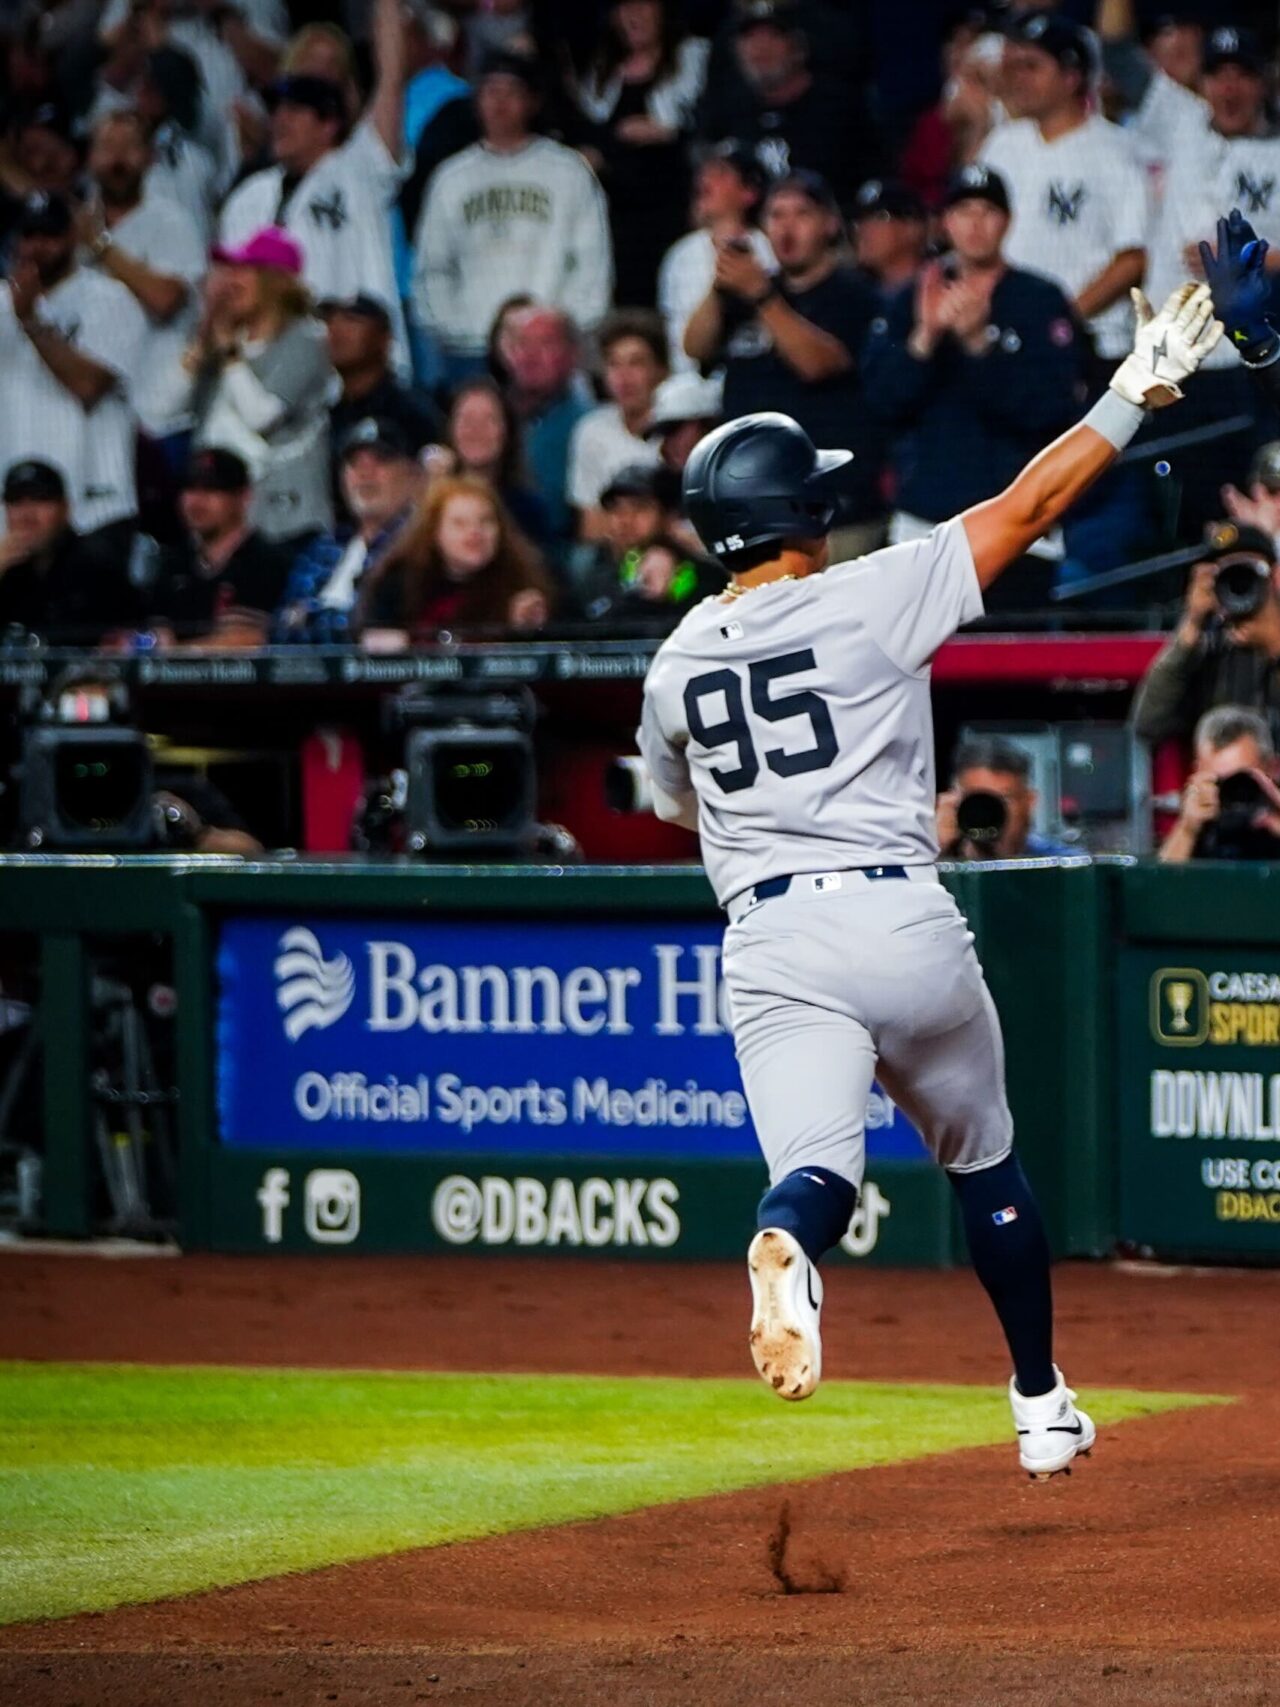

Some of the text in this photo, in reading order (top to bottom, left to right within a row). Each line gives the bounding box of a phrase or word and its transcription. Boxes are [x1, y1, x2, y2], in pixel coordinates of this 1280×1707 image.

[725, 533, 745, 552] 95
[683, 648, 840, 794] 95
[366, 941, 642, 1036] Banner
[295, 1071, 429, 1122] Official
[435, 1073, 567, 1134] Sports
[571, 1076, 747, 1128] Medicine
[1202, 1158, 1249, 1189] USE
[432, 1174, 681, 1248] @DBACKS
